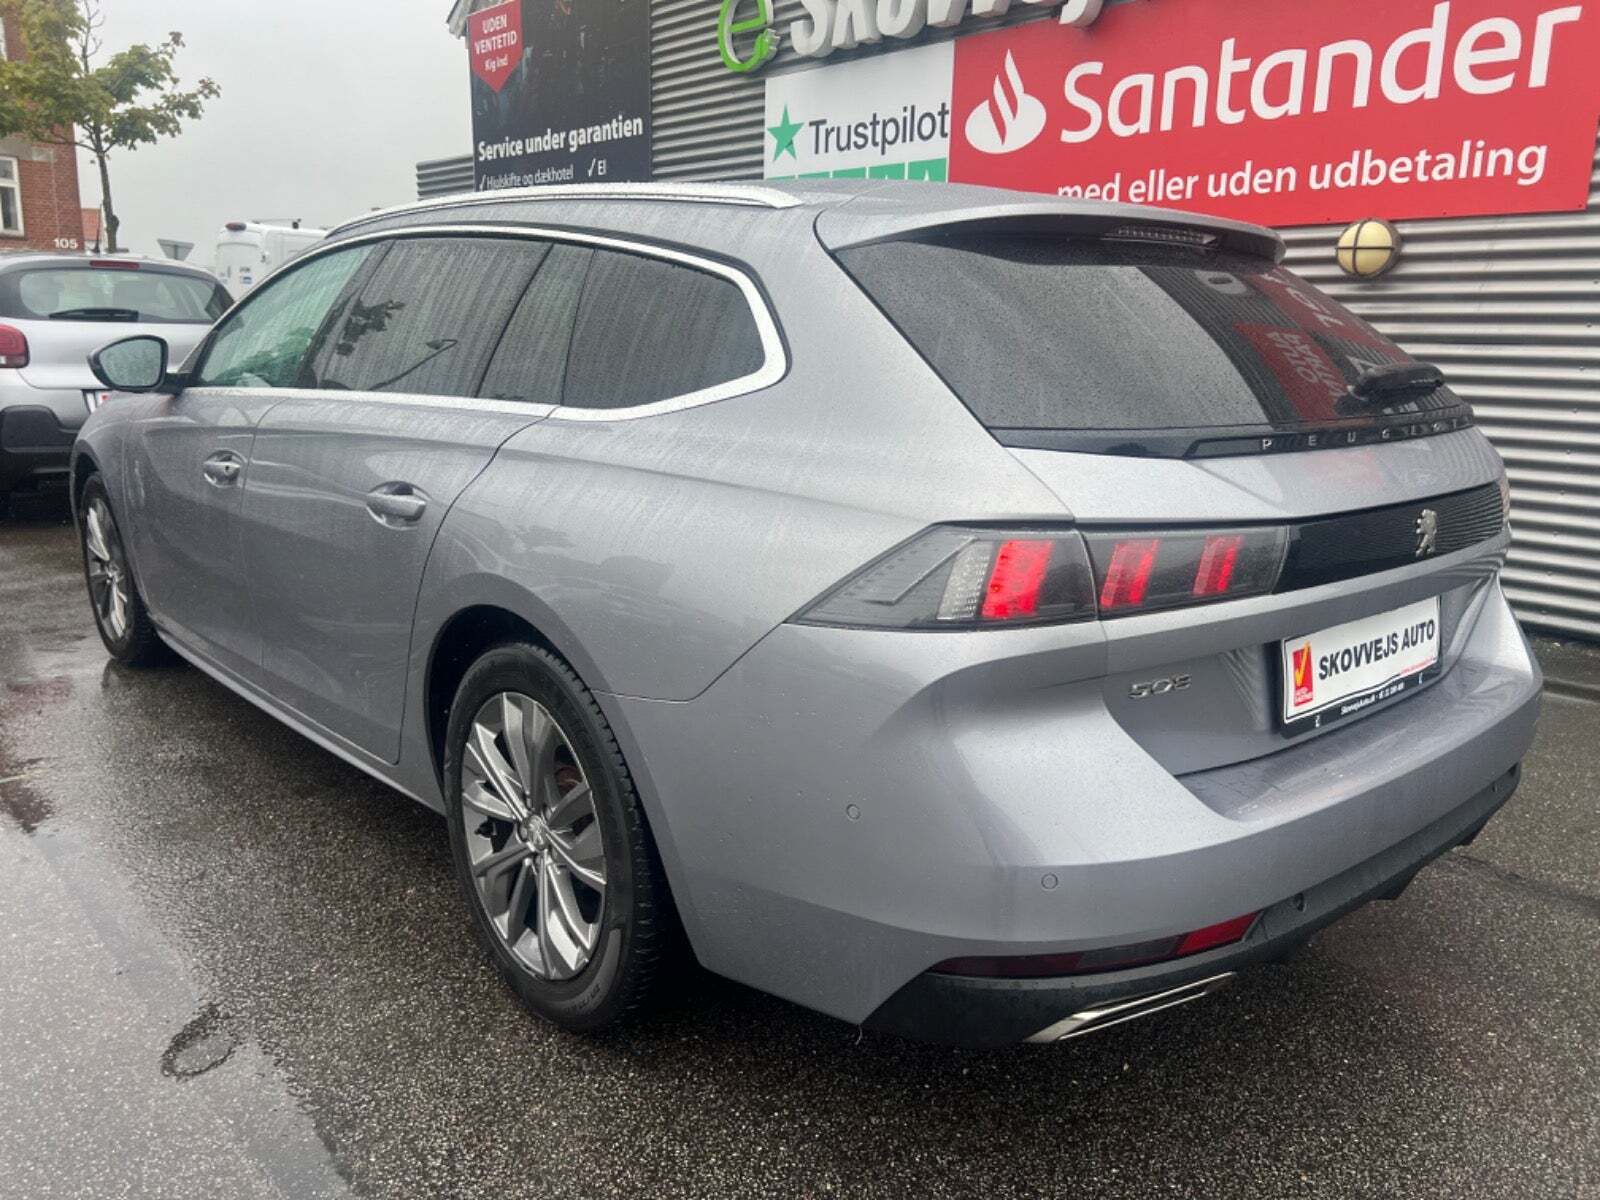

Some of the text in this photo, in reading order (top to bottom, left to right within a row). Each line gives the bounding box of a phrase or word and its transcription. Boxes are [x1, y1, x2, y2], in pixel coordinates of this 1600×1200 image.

[474, 31, 517, 55] VENTETID
[482, 14, 507, 34] UDEN
[1060, 1, 1582, 143] Santander
[478, 114, 644, 161] Service under garantien
[809, 102, 950, 155] Trustpilot
[1128, 168, 1199, 203] eller
[1207, 161, 1297, 198] uden
[1309, 140, 1548, 189] udbetaling
[53, 237, 79, 249] 105
[1319, 632, 1399, 680] SKOVVEJS
[1401, 619, 1435, 651] AUTO
